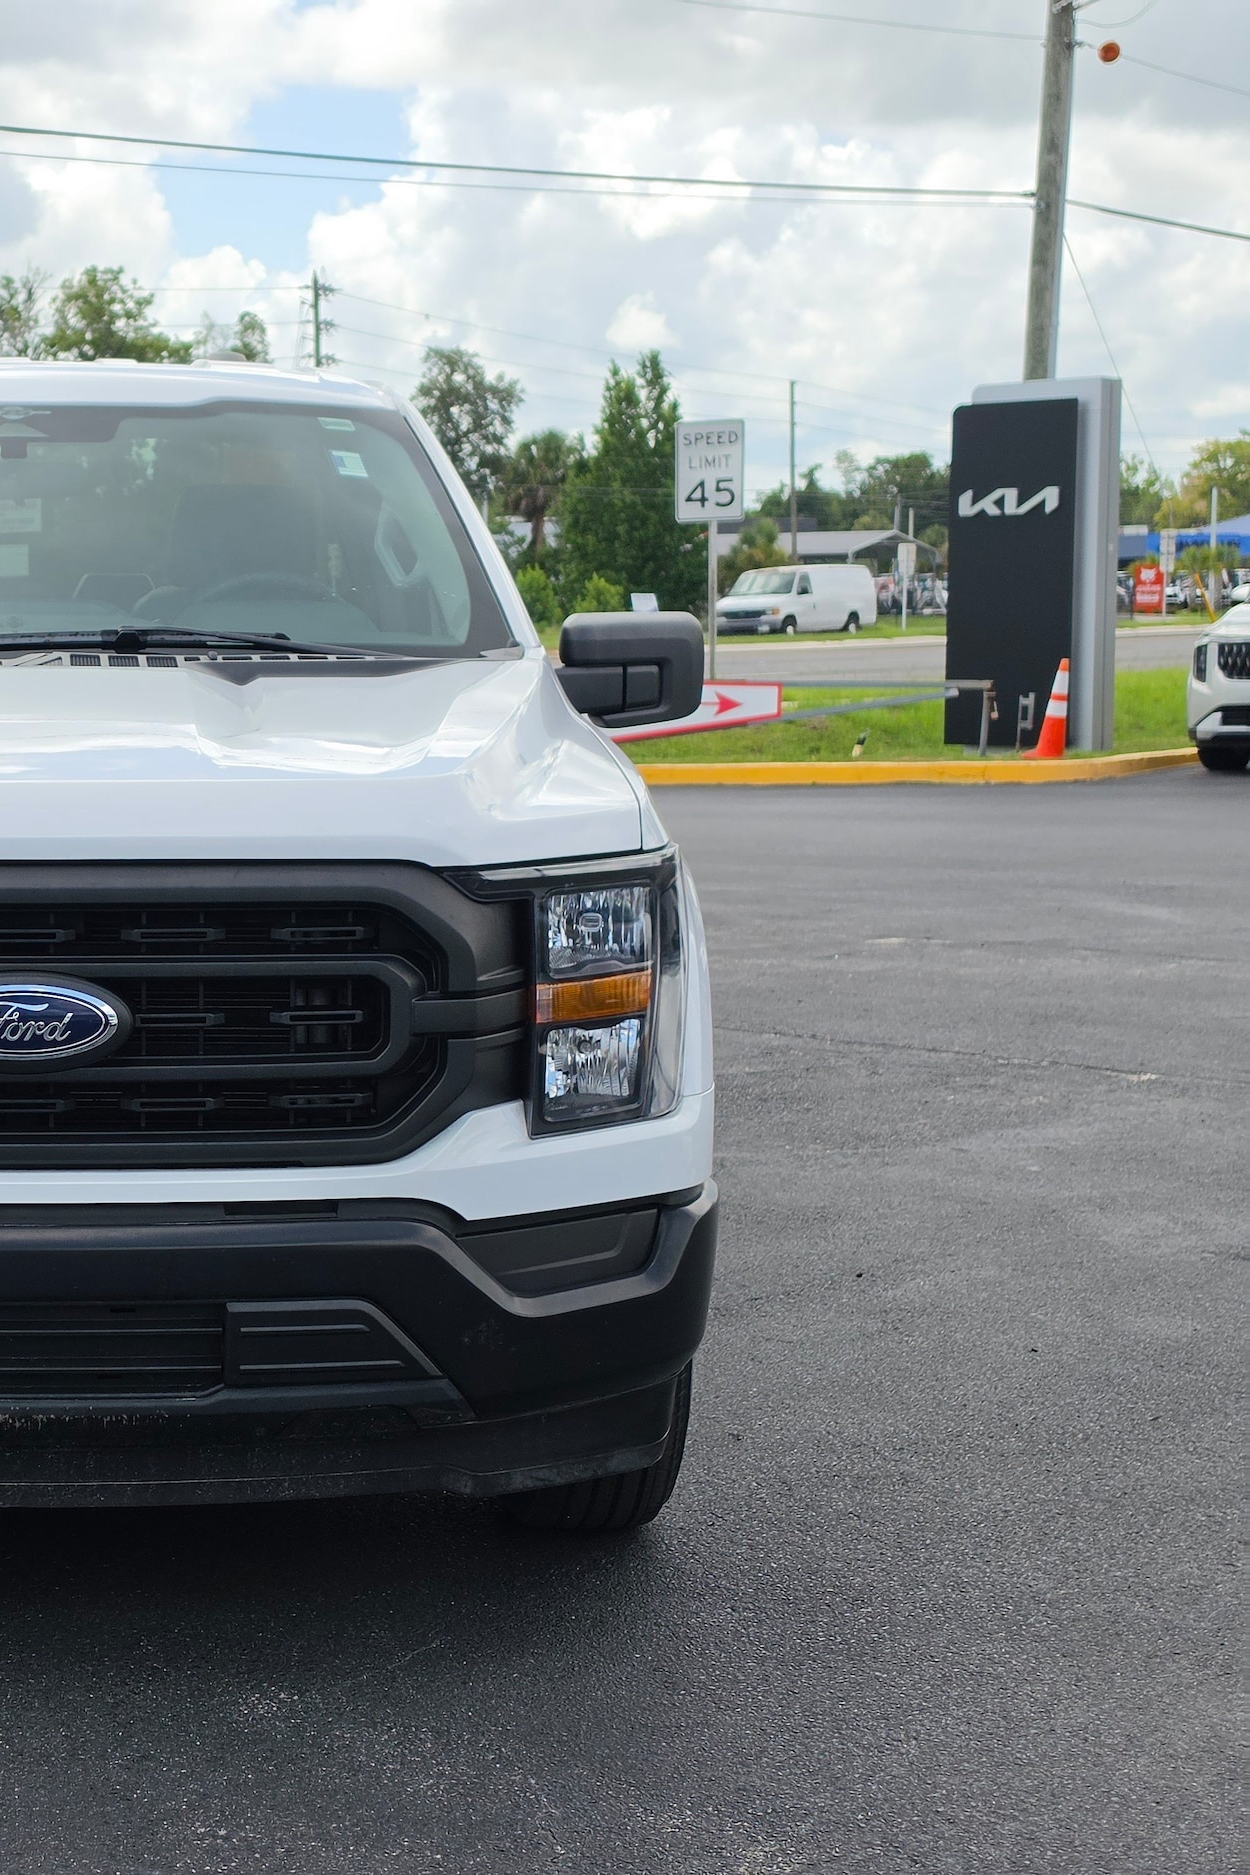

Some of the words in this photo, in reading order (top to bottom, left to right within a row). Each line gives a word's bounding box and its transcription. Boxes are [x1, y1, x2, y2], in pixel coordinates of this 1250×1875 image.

[683, 430, 739, 446] SPEED
[688, 453, 733, 470] LIMIT
[685, 477, 736, 508] 45
